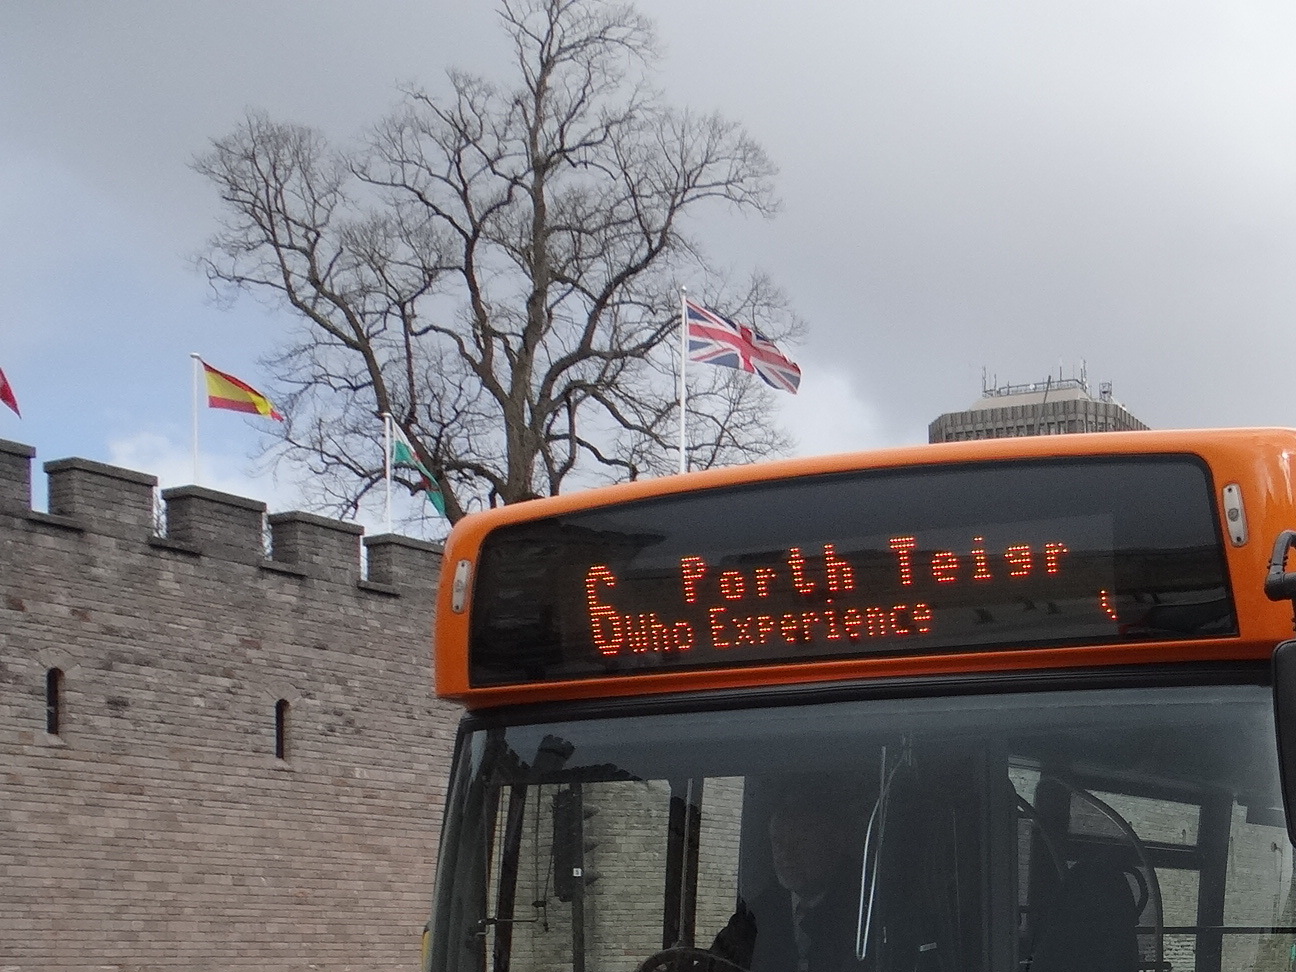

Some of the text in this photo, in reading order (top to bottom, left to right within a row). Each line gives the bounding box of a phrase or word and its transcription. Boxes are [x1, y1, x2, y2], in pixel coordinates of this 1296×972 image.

[680, 535, 1068, 604] Porth Teigr
[585, 565, 624, 656] 6
[709, 598, 932, 649] Experience
